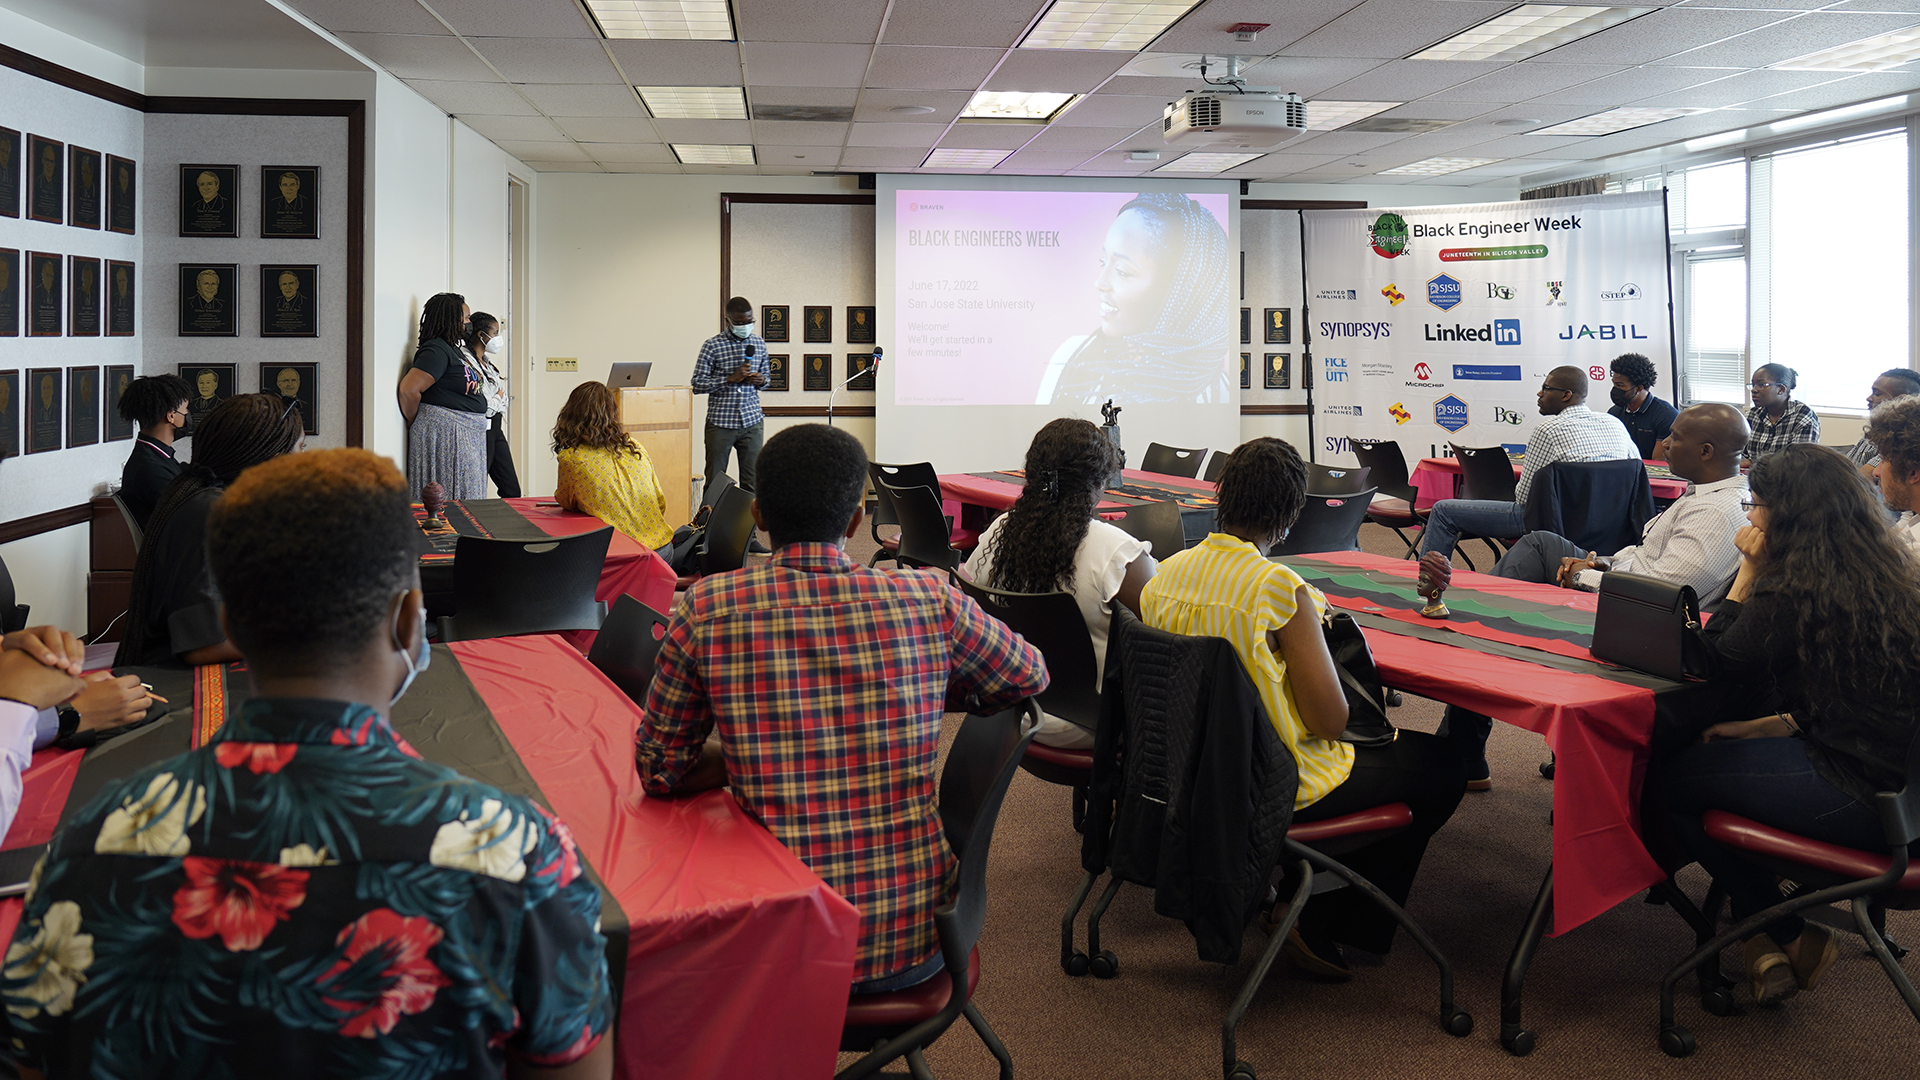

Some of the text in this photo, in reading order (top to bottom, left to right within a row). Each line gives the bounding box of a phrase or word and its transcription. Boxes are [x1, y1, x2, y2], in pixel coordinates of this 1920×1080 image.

[1367, 222, 1393, 232] BLACK
[1413, 214, 1582, 239] Black Engineer Week
[908, 229, 1060, 248] BLACK ENGINEERS WEEK
[907, 280, 979, 292] June 17, 2022
[1439, 283, 1460, 293] SJSU
[907, 298, 1036, 312] San Jose State University
[907, 322, 950, 332] Welcome!
[1320, 321, 1390, 340] SYNOPSYS
[1558, 324, 1648, 340] JABIL
[907, 335, 928, 344] We'll
[929, 336, 944, 346] get
[945, 335, 976, 345] started
[977, 335, 986, 344] in
[907, 347, 962, 357] few minutes!
[1446, 405, 1467, 415] SJSU
